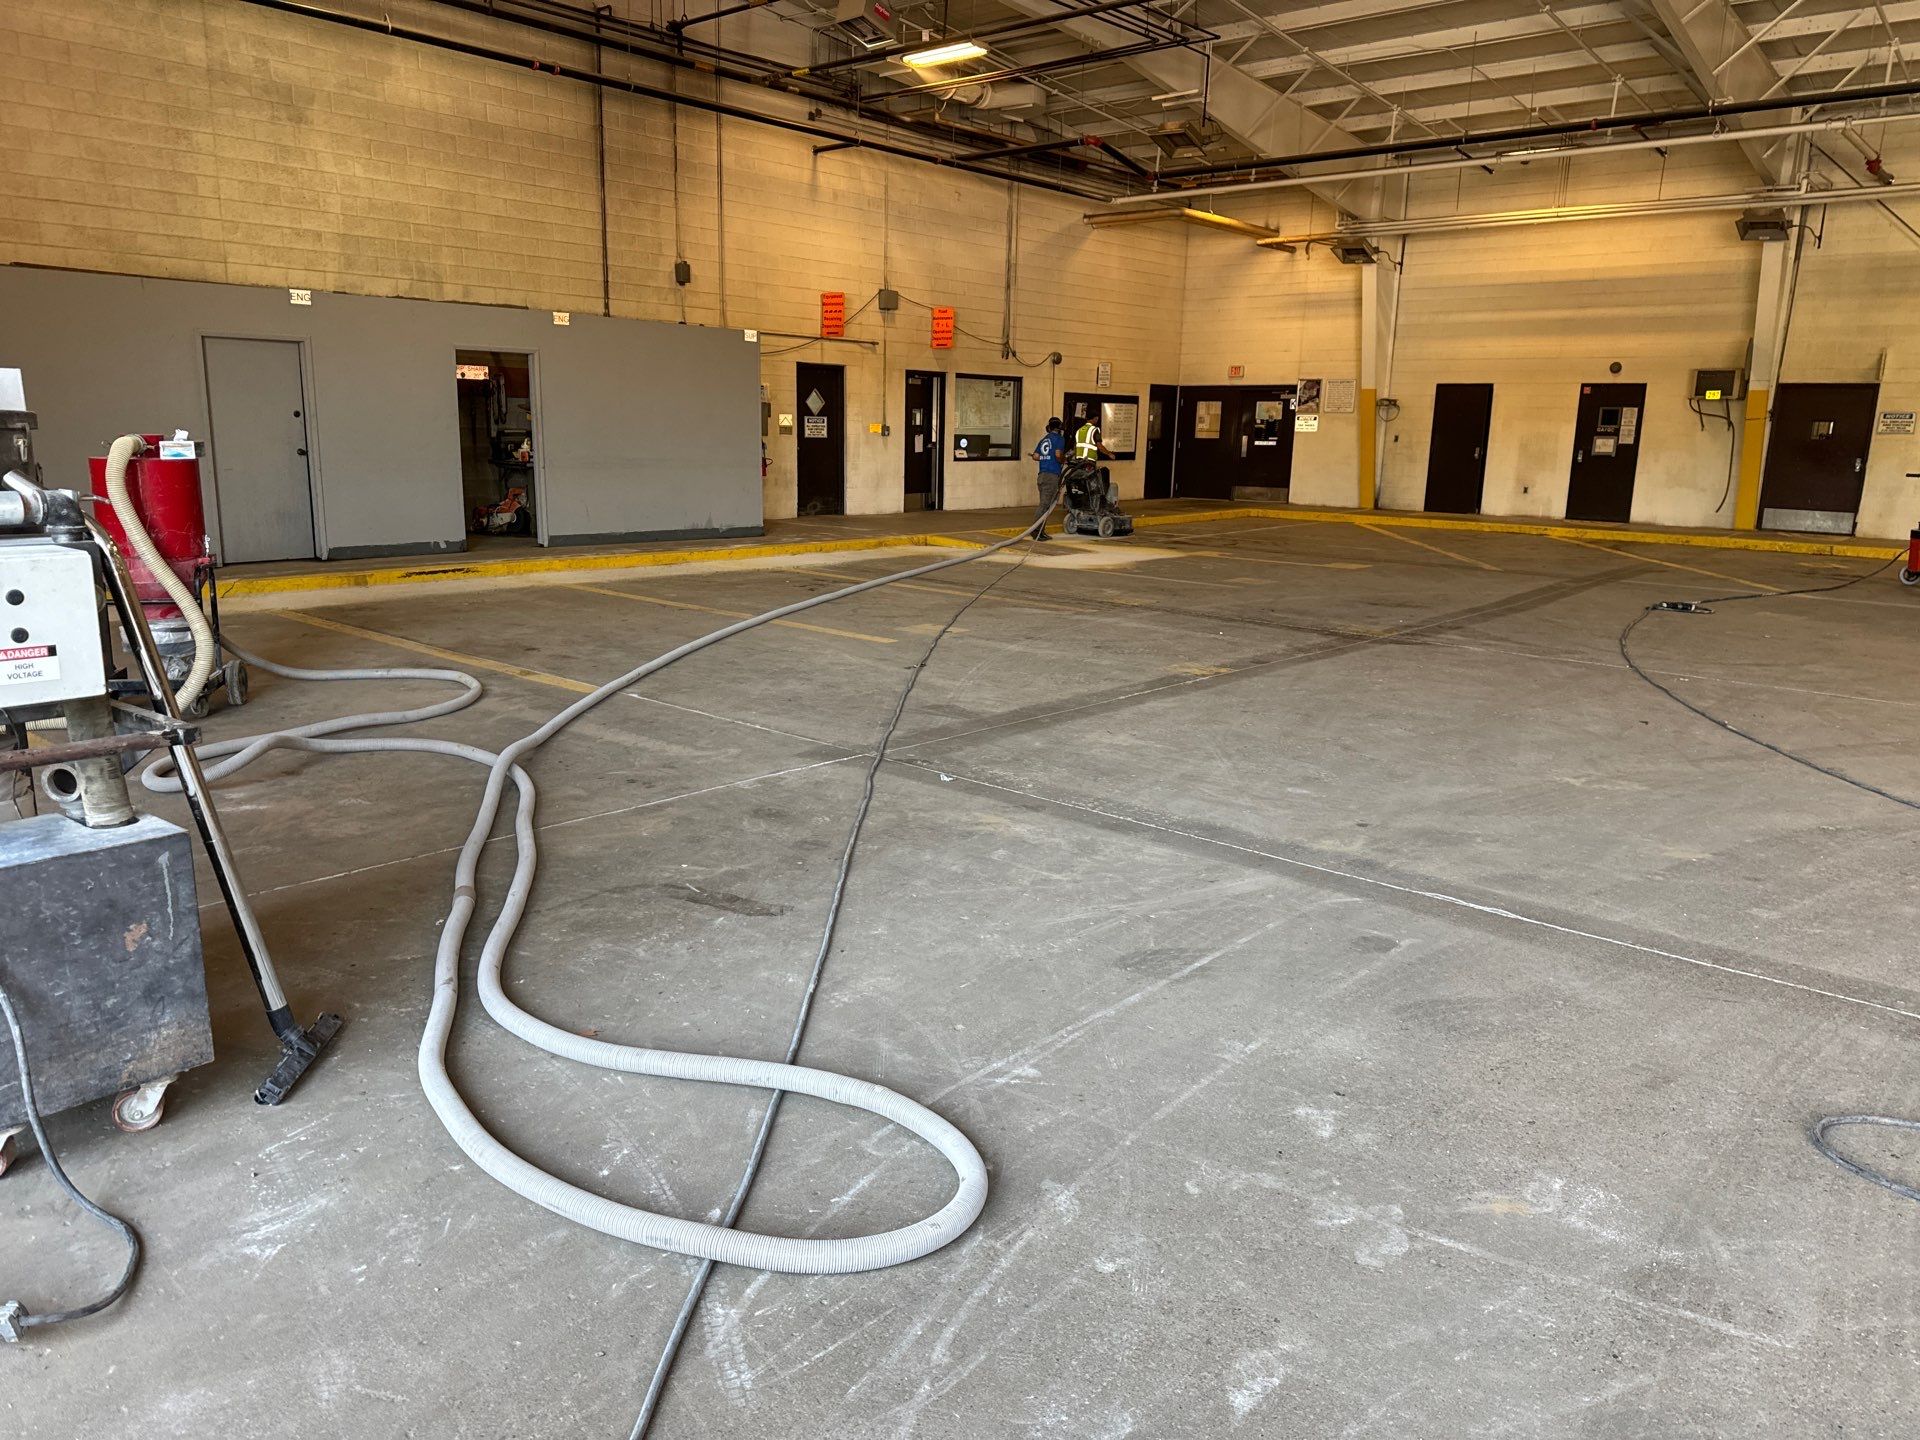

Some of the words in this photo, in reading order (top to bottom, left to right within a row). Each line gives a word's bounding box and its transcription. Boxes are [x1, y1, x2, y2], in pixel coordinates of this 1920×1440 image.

[290, 292, 311, 301] ENG
[6, 647, 48, 659] DANGER
[7, 671, 43, 680] VOLTAGE
